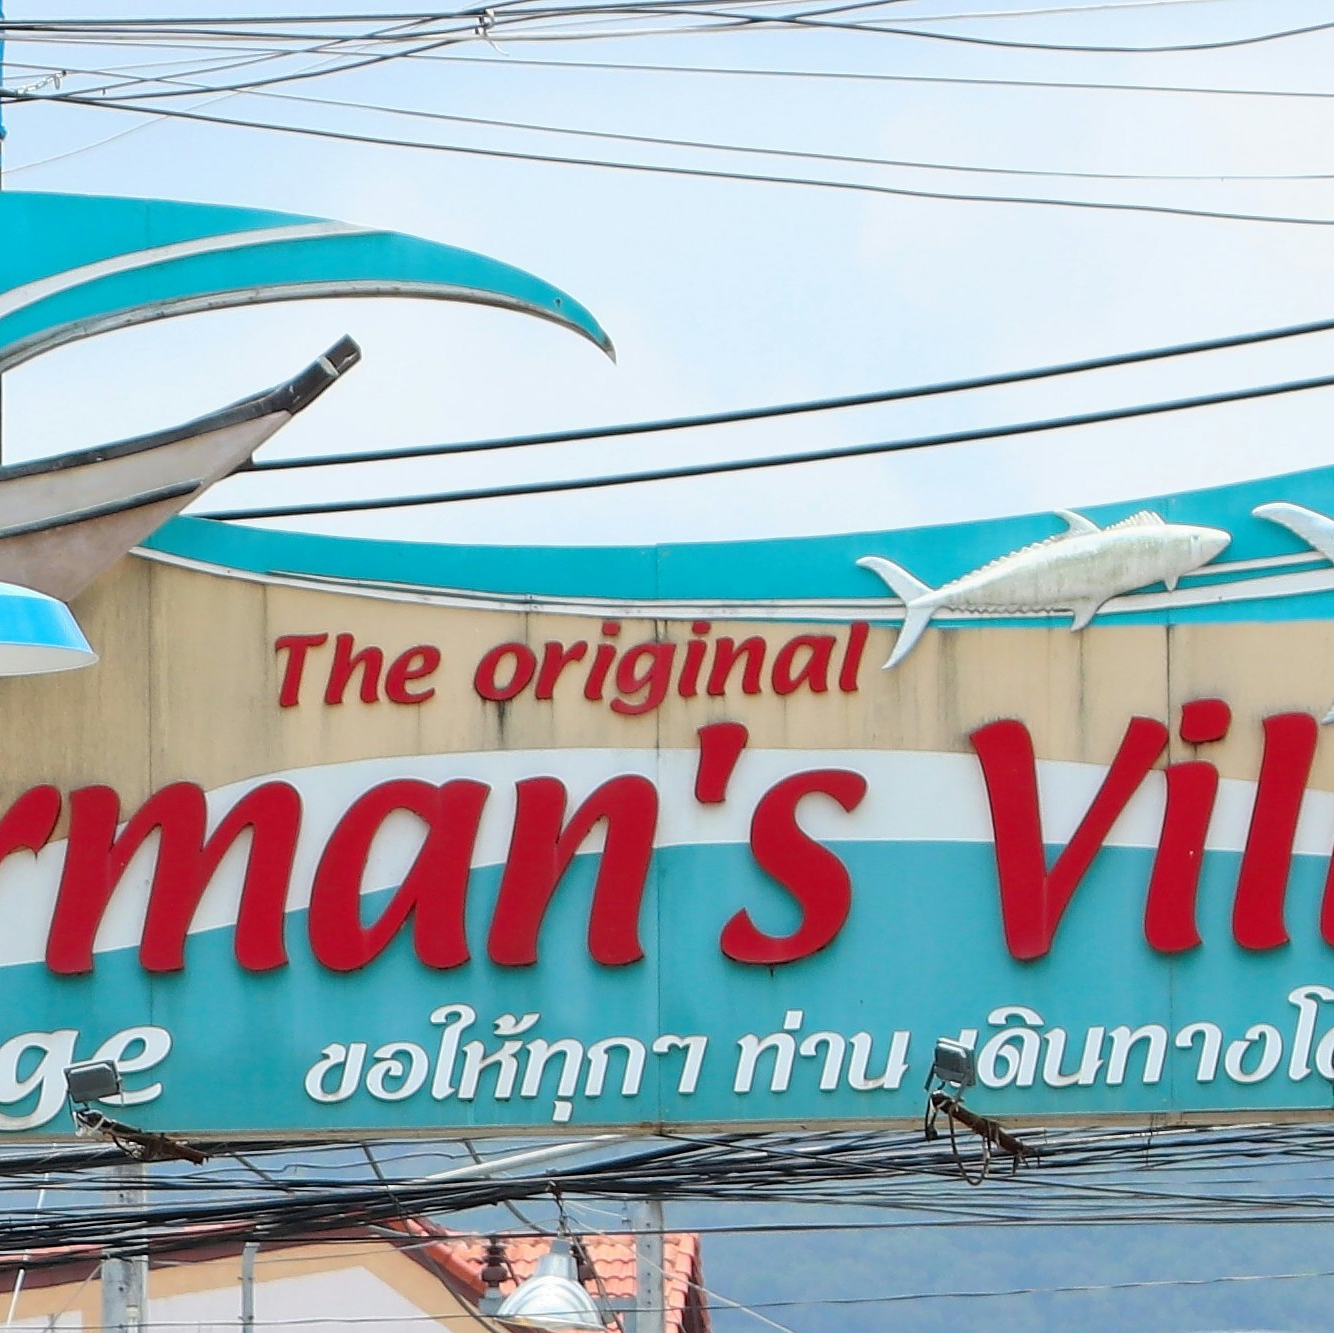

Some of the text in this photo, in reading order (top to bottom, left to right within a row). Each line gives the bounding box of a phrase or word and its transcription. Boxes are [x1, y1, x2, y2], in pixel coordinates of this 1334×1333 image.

[274, 620, 871, 716] The original
[732, 1010, 911, 1094] ท่าน
